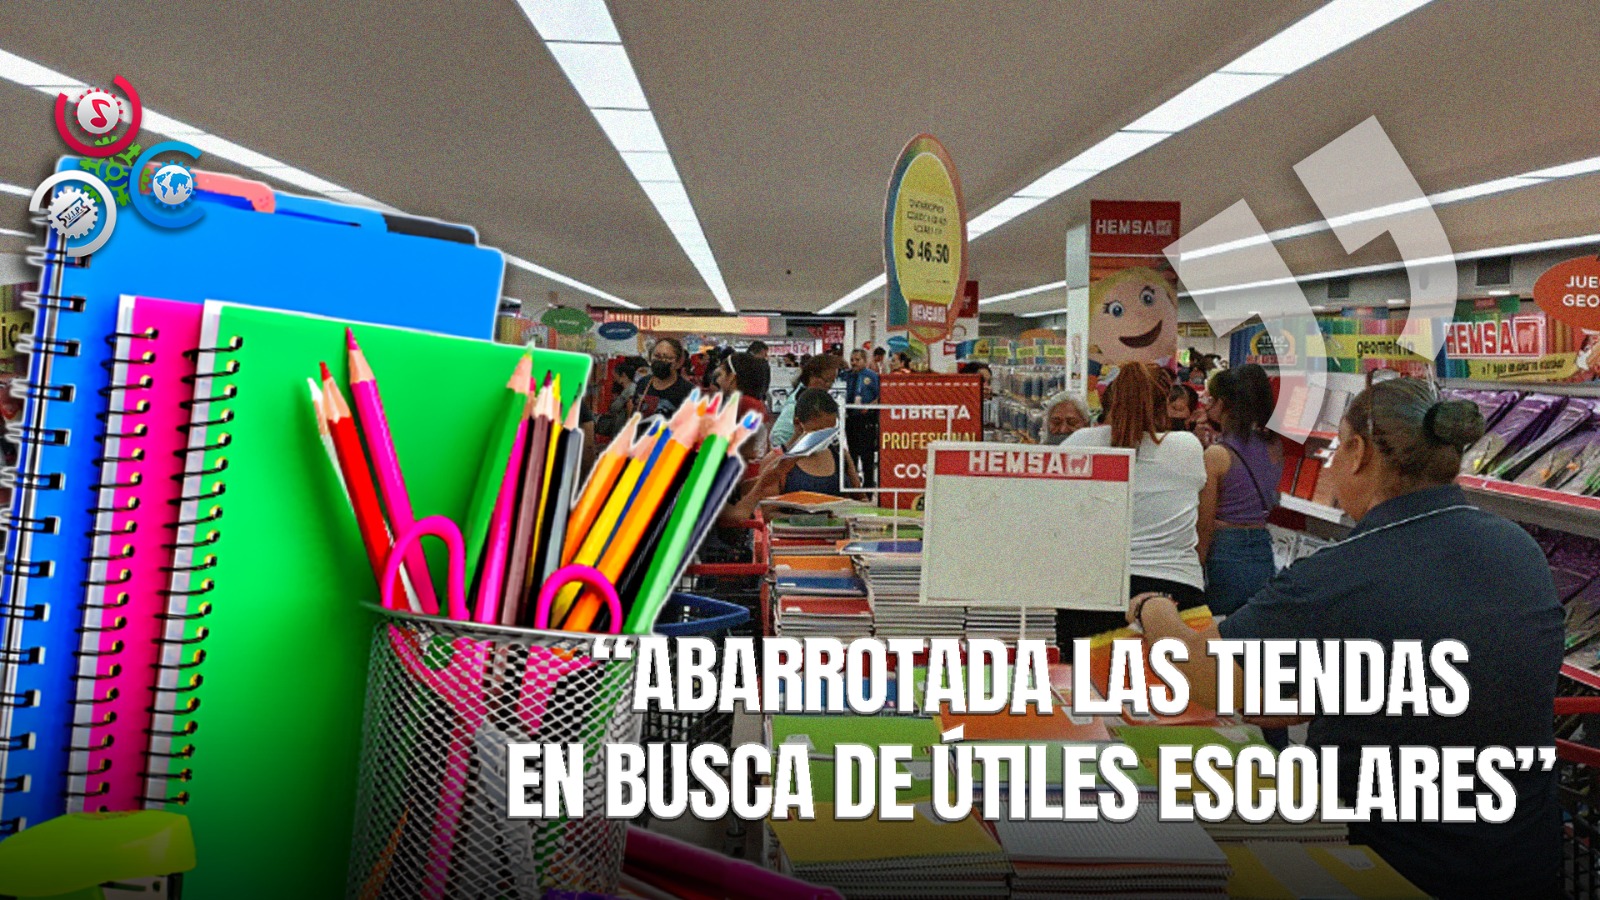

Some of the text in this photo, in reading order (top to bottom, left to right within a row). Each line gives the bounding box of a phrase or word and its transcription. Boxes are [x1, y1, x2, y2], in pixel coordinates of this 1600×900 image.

[1096, 219, 1154, 235] HEMSA
[906, 239, 914, 259] $
[1444, 320, 1515, 358] HEMSA
[890, 405, 971, 420] LIBRETA
[969, 451, 1063, 474] HEMSA
